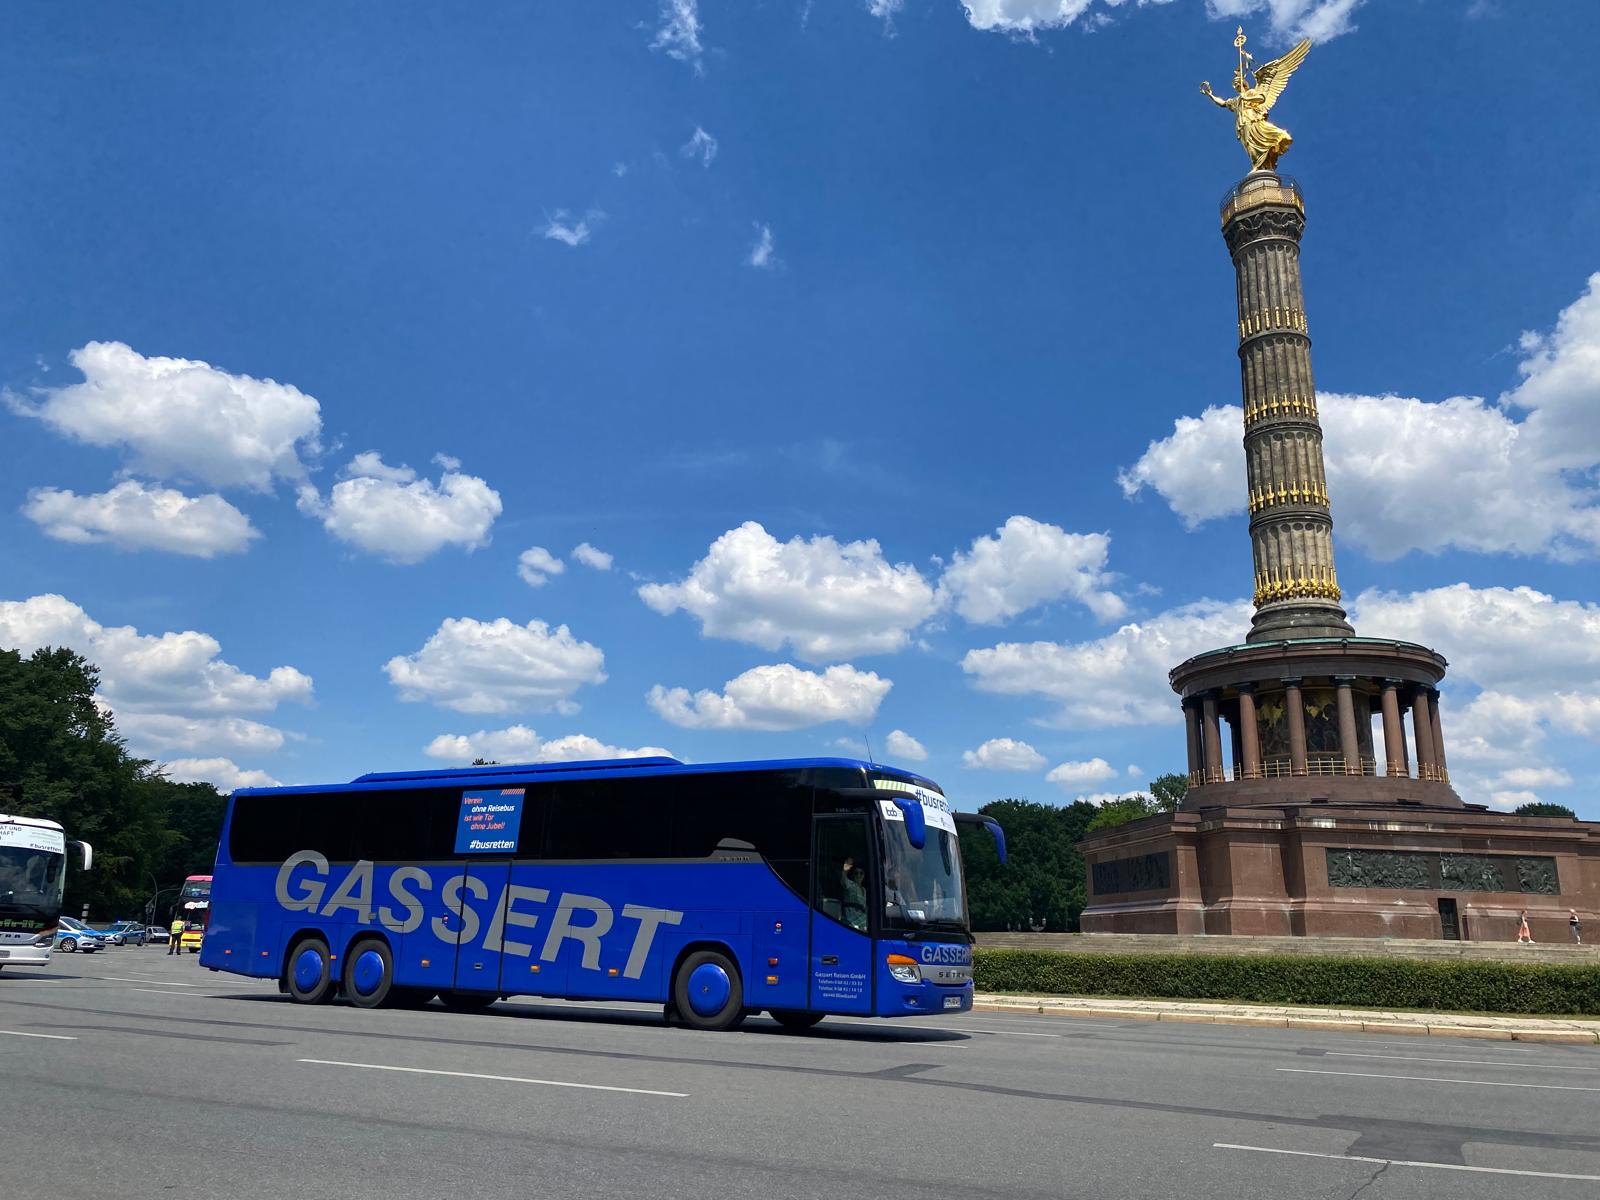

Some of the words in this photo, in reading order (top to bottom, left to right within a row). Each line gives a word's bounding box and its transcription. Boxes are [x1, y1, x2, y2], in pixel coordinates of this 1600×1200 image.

[488, 804, 515, 812] Reisebus
[915, 788, 952, 815] #busrett
[469, 840, 515, 849] #busretten
[275, 849, 684, 980] GASSERT
